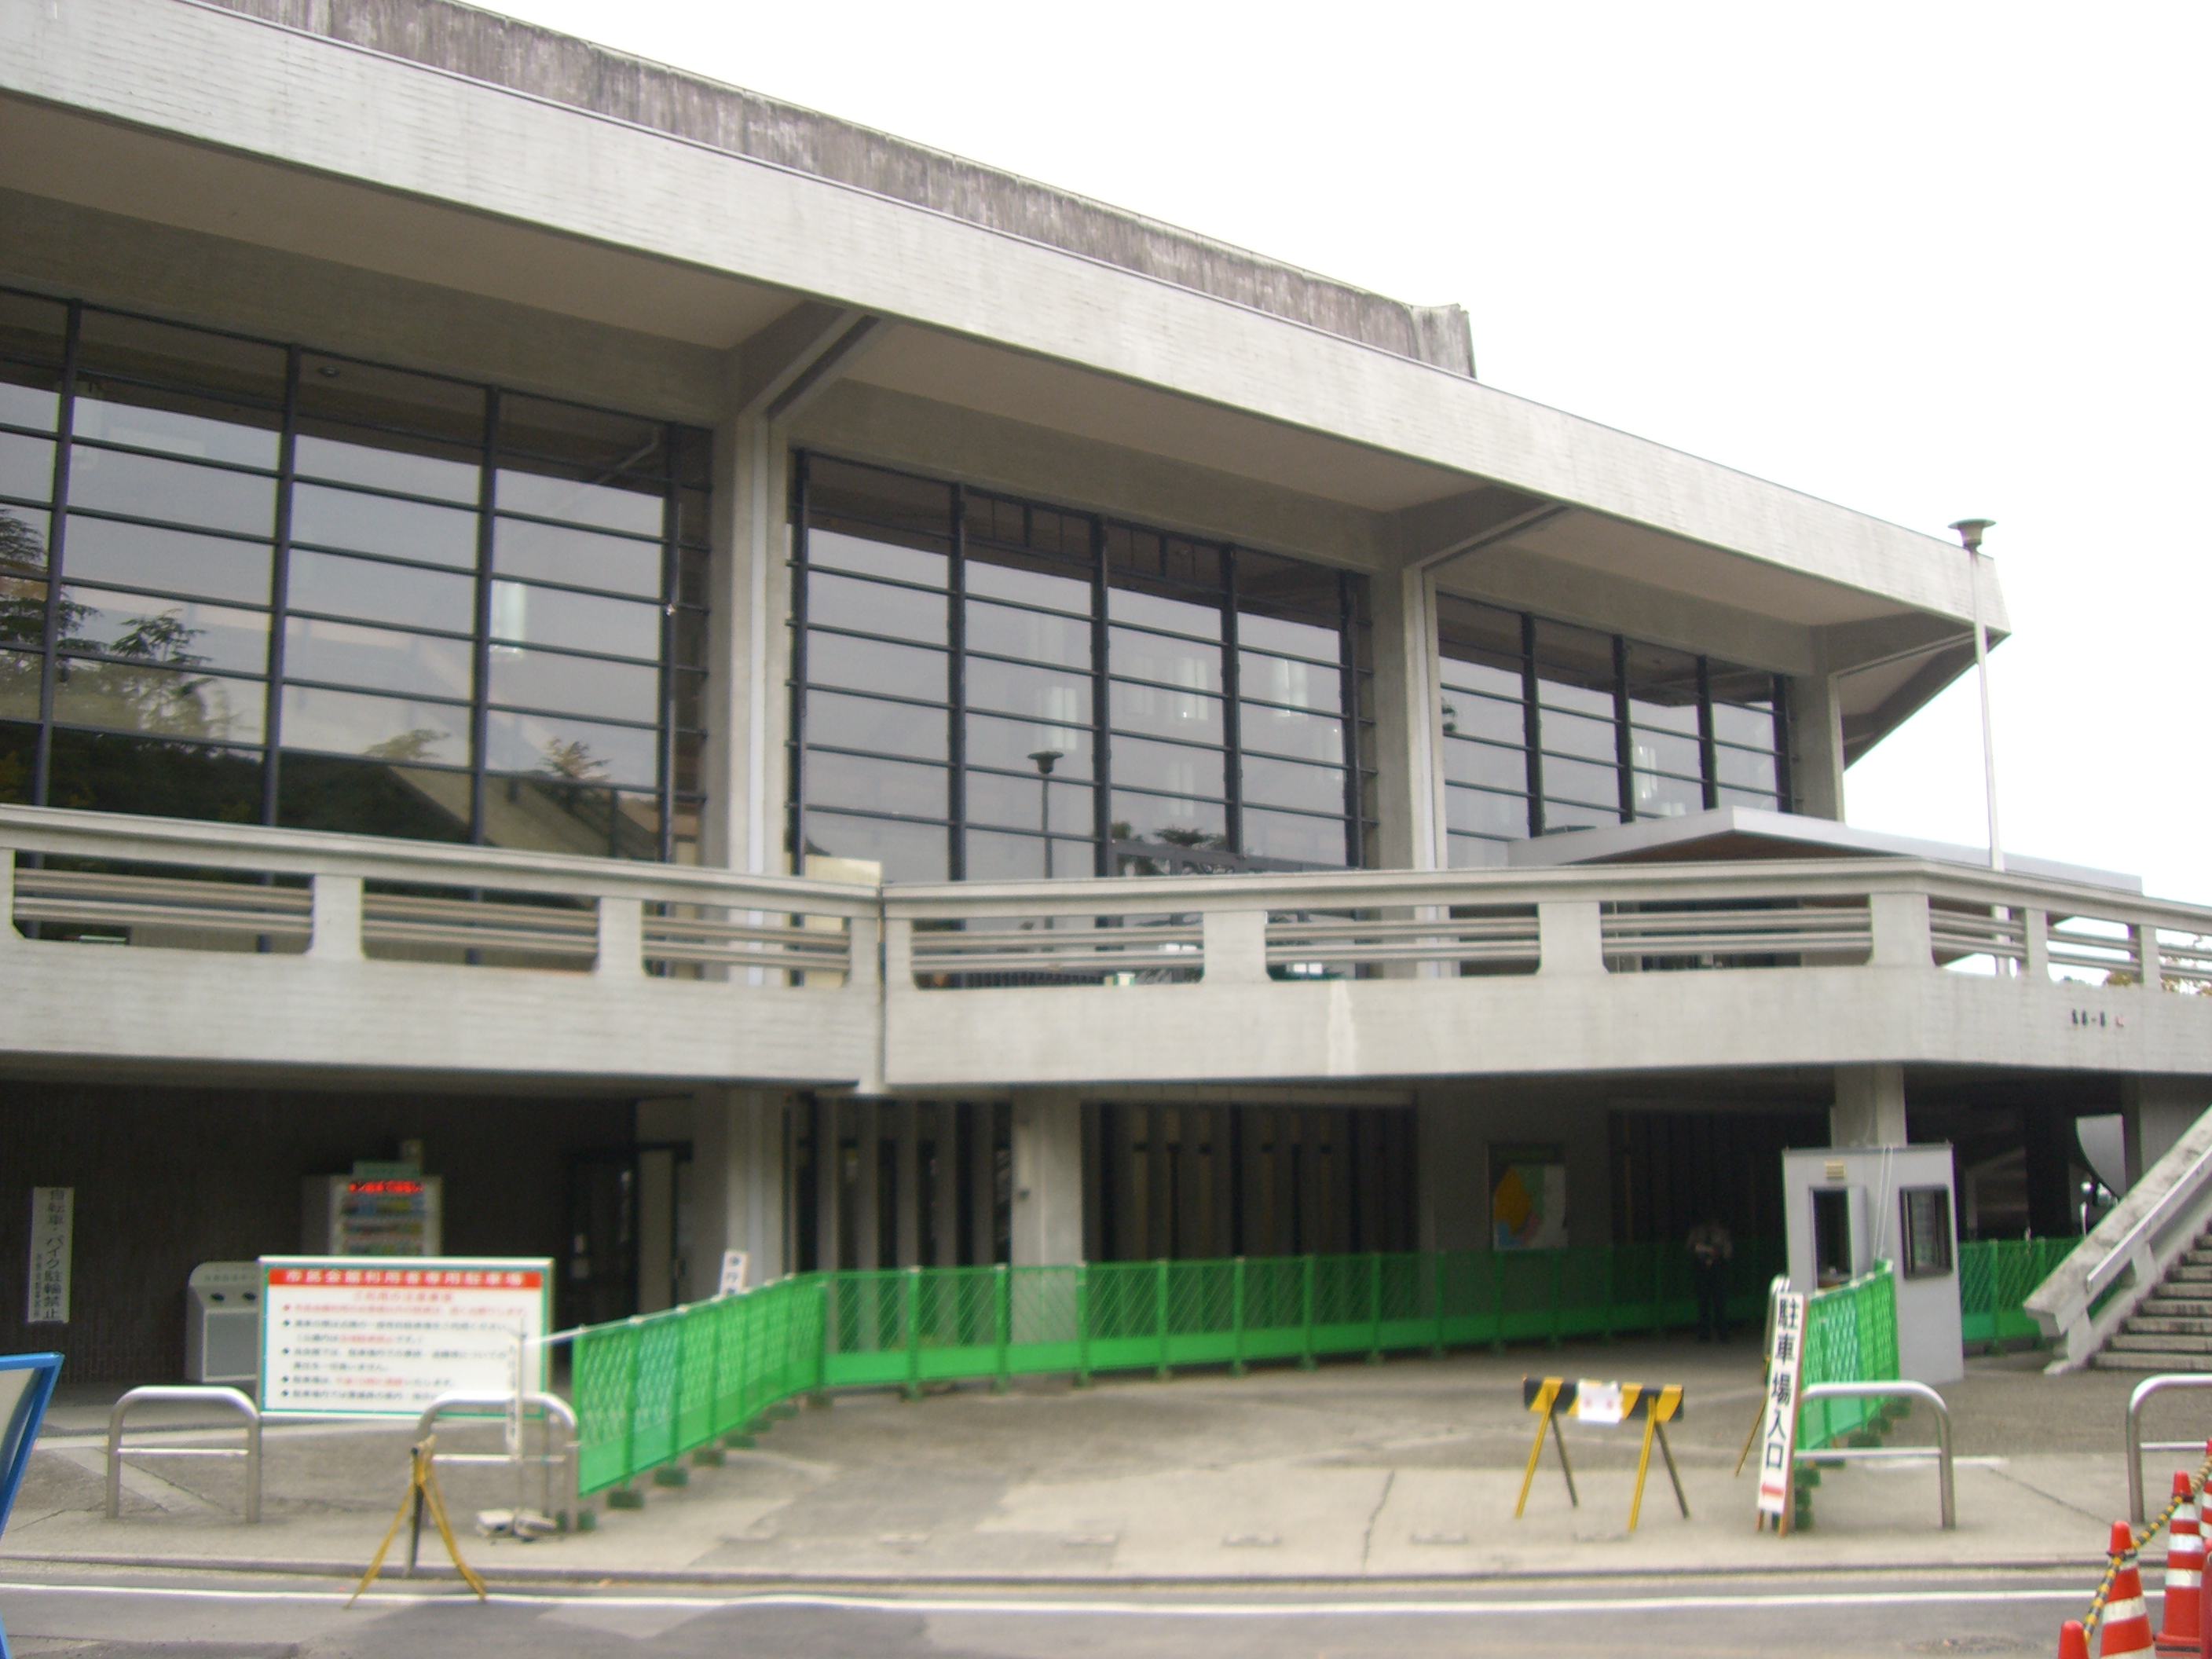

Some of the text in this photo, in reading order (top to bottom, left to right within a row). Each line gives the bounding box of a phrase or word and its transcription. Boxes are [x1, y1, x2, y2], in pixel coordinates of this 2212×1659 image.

[1766, 1297, 1800, 1471] 駐車場入口
